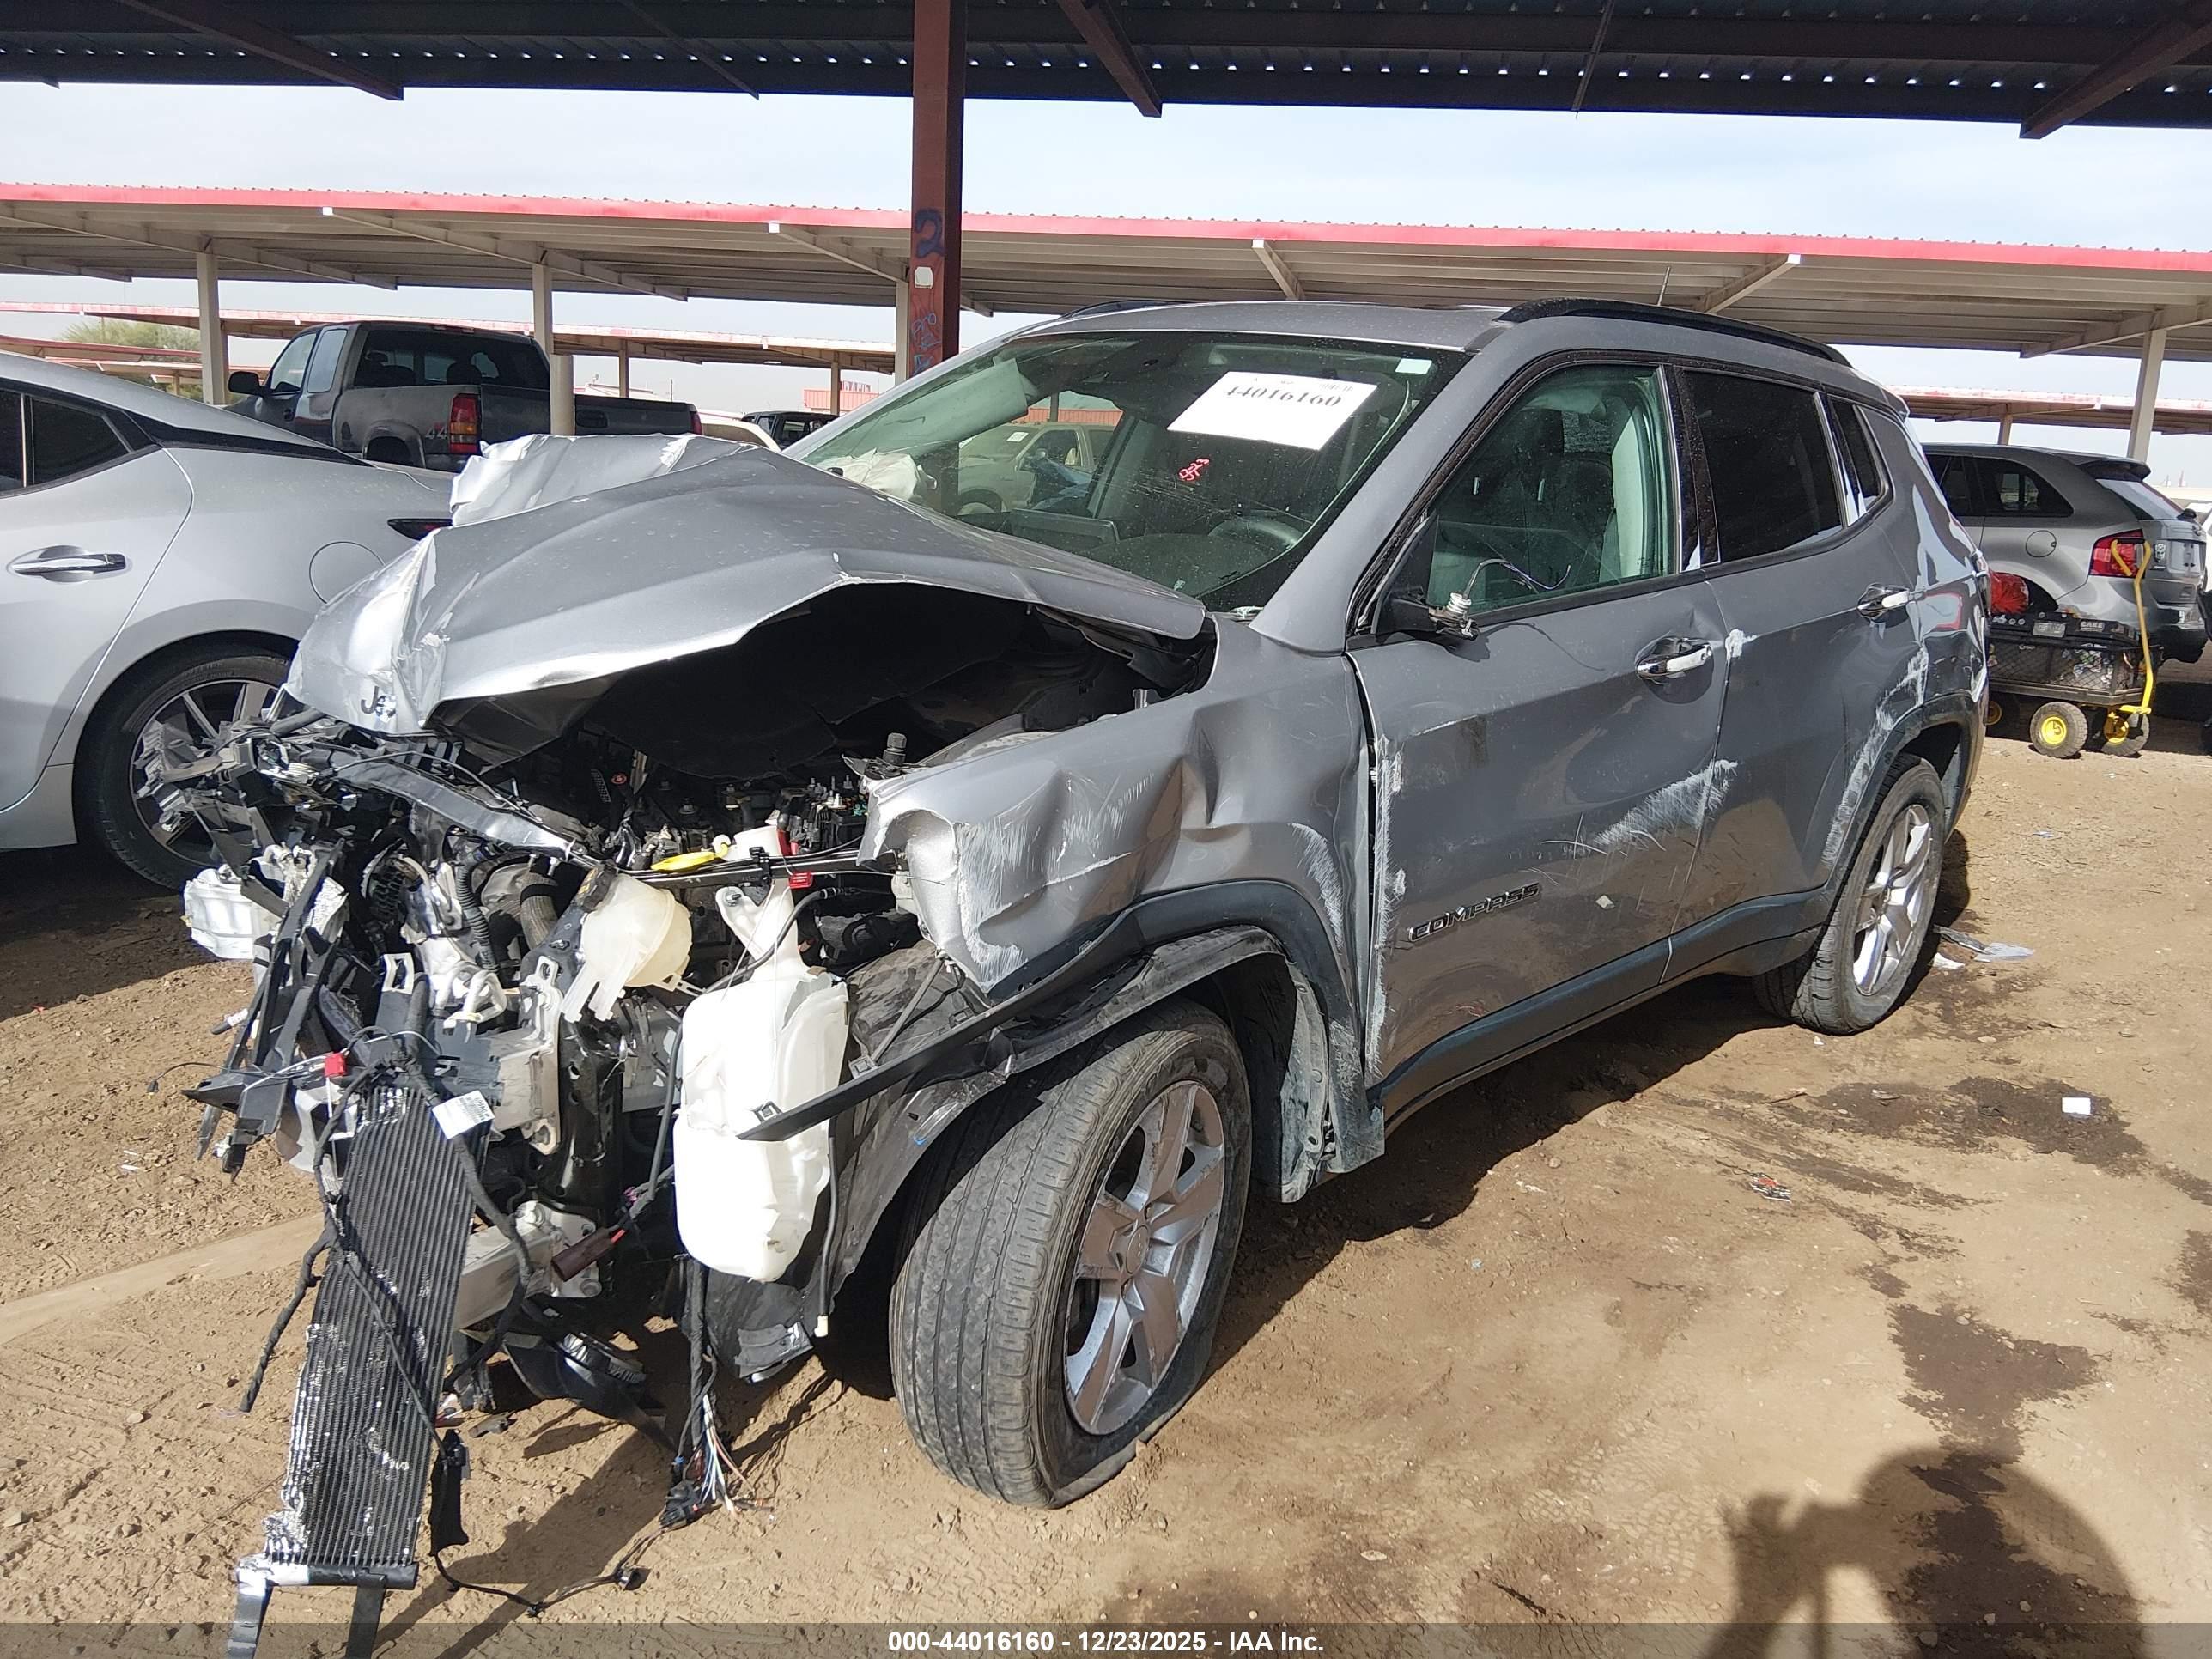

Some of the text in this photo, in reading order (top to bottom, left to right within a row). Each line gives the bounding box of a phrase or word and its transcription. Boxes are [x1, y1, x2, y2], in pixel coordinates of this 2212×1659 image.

[915, 207, 945, 259] 2
[1223, 385, 1342, 407] 44016160
[1407, 882, 1540, 942] COMPASS
